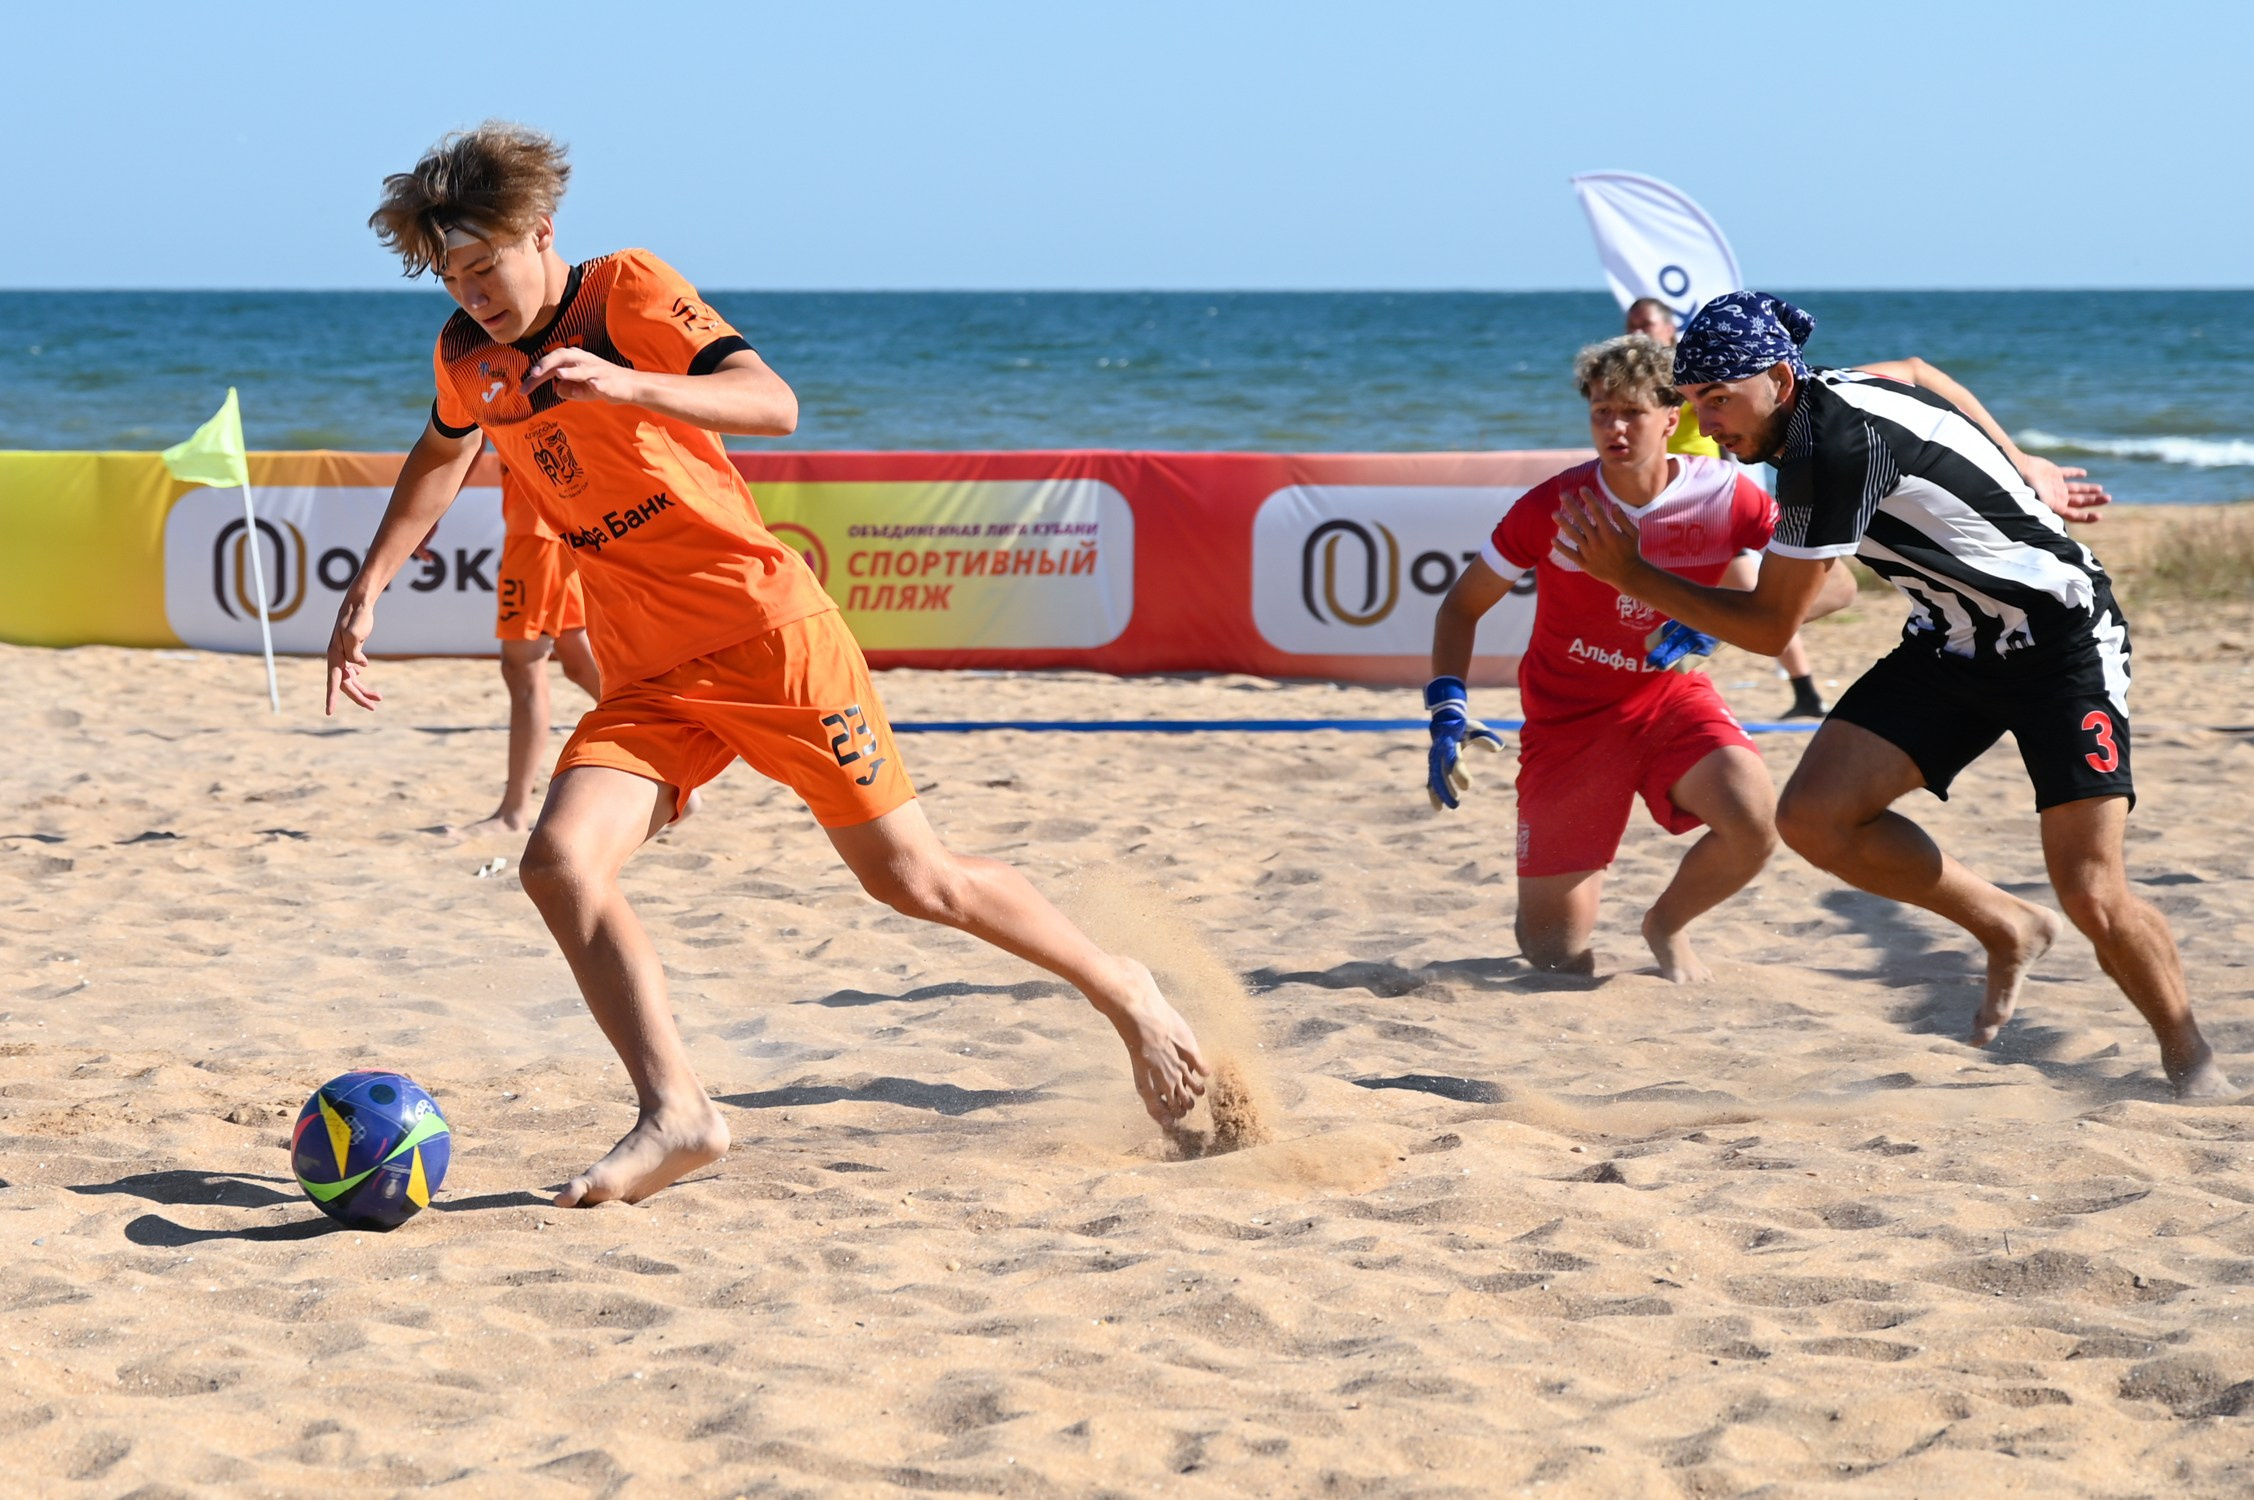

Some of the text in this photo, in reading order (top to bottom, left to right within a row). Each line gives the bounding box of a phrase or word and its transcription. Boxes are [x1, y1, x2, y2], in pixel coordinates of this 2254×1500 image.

[602, 492, 676, 539] Банк
[847, 539, 1098, 578] СПОРТИВНЫЙ
[846, 584, 955, 611] ПЛЯЖ
[1568, 637, 1637, 672] Альфа
[821, 704, 877, 767] 23
[2081, 710, 2119, 773] 3
